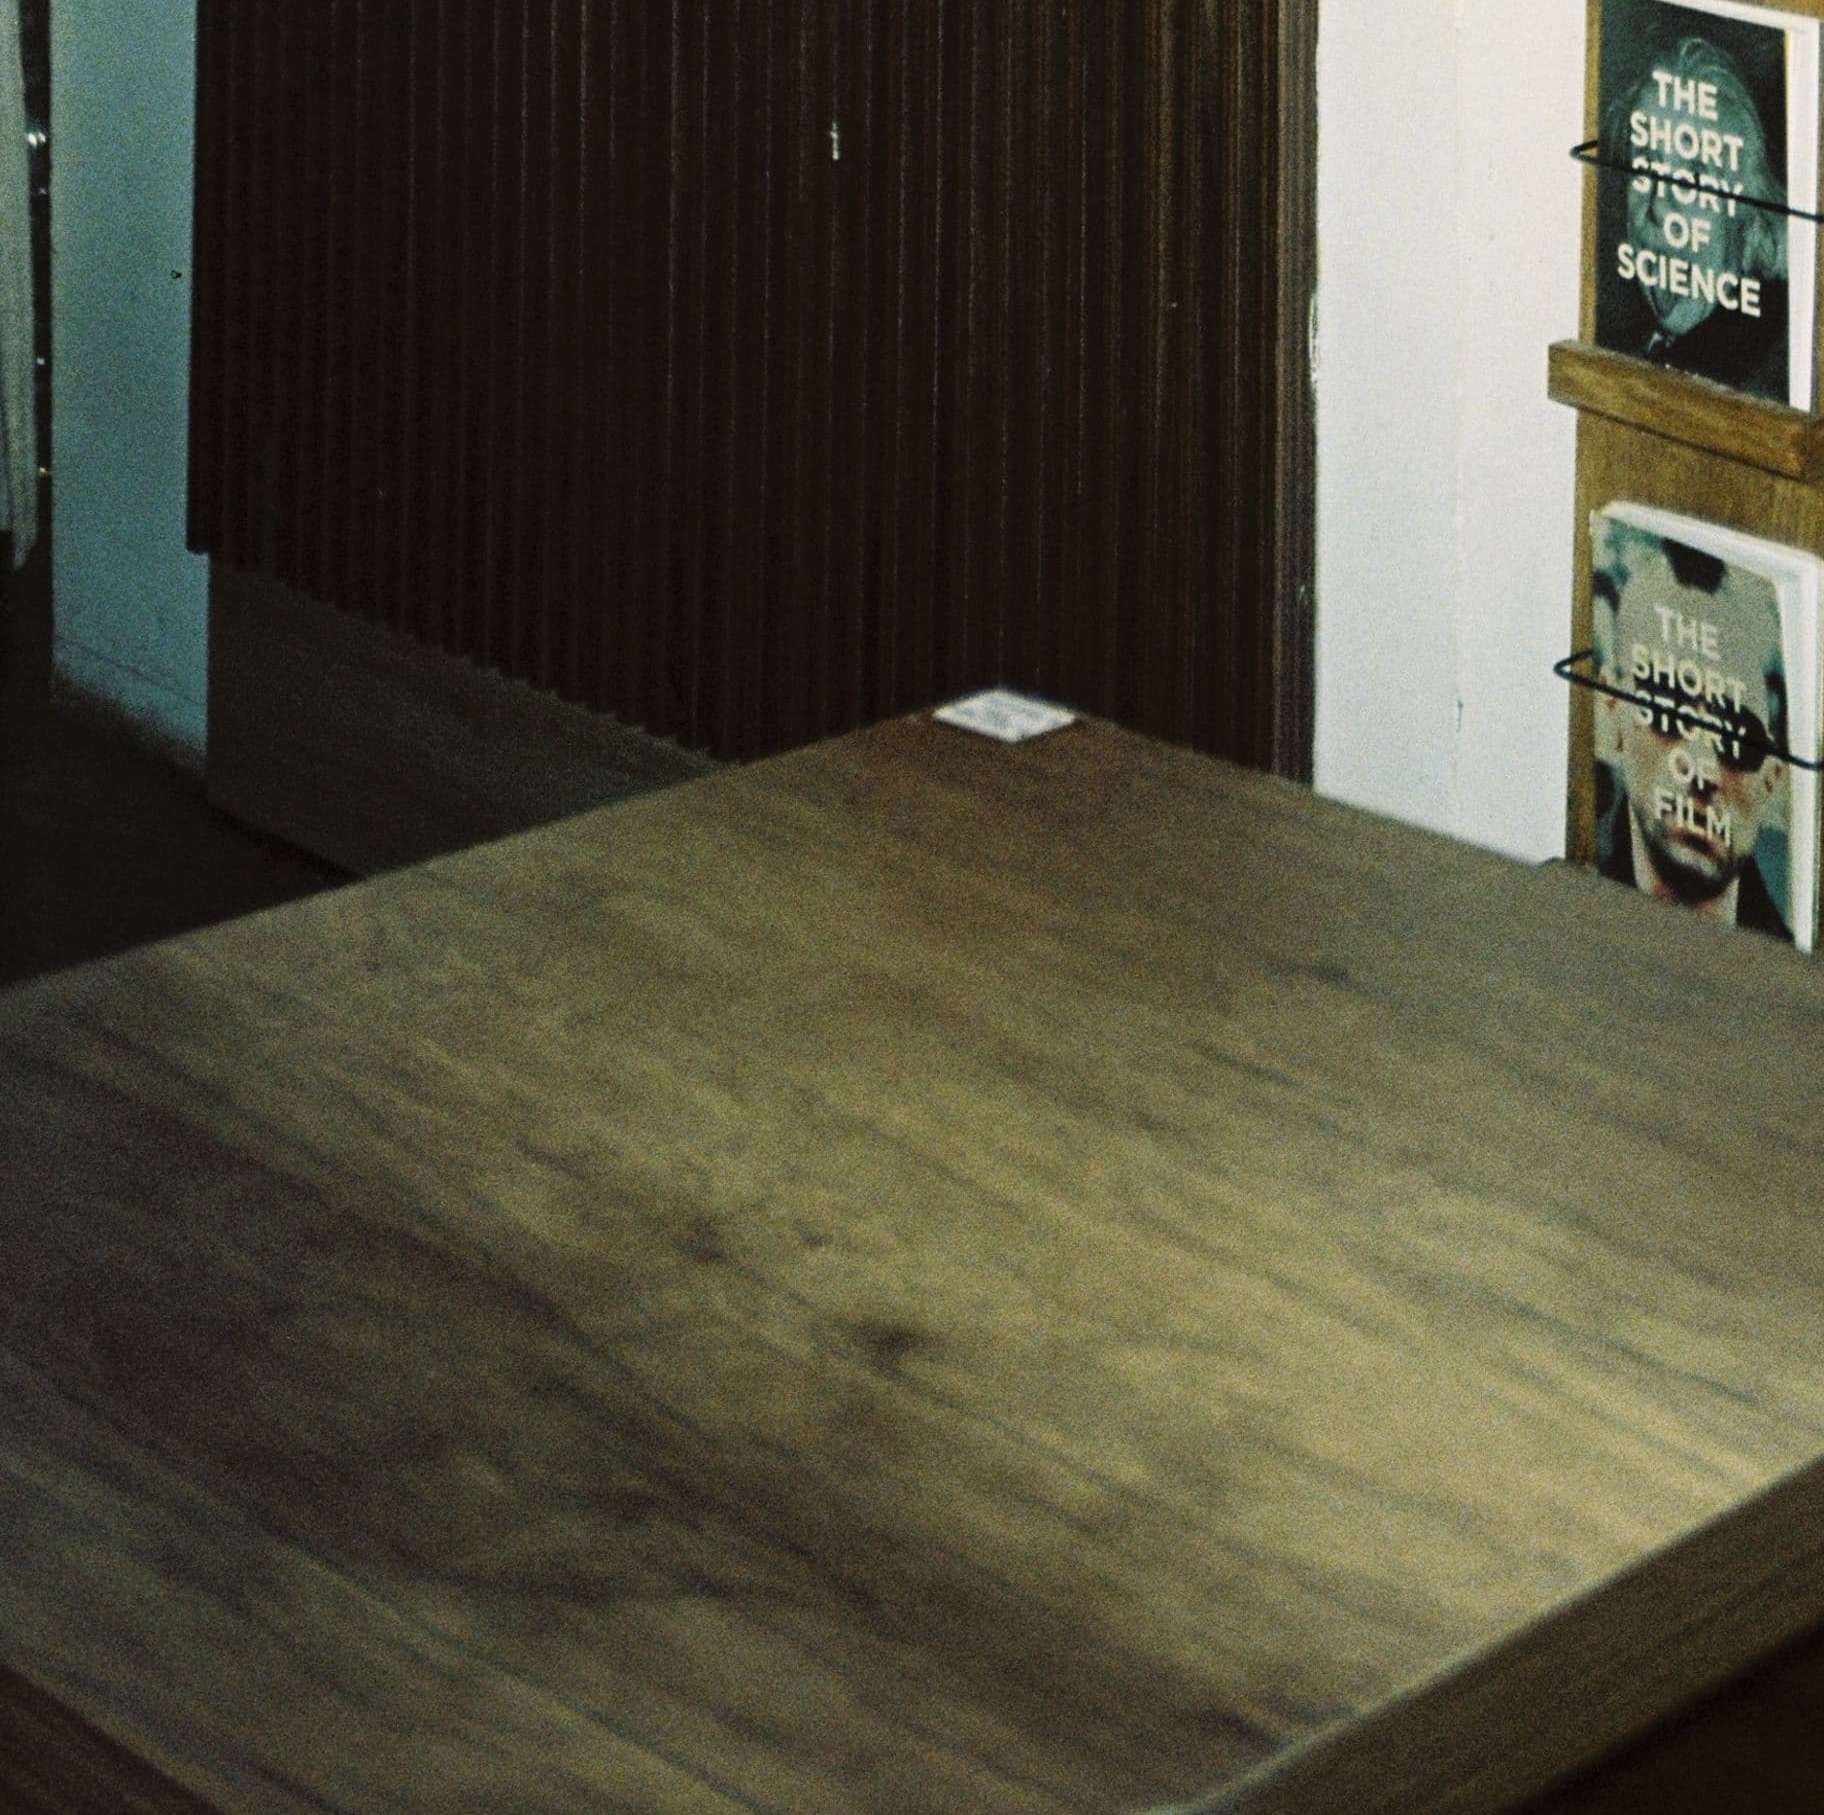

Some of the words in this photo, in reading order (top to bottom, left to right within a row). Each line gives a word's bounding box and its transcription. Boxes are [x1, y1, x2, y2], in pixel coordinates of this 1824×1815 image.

[1651, 69, 1719, 122] THE
[1629, 110, 1745, 172] SHORT
[1630, 156, 1745, 218] STORY
[1662, 211, 1712, 253] OF
[1616, 242, 1762, 318] SCIENCE
[1653, 603, 1721, 662] THE
[1631, 643, 1748, 715] SHORT
[1668, 747, 1713, 791] OF
[1653, 784, 1732, 849] FILM
